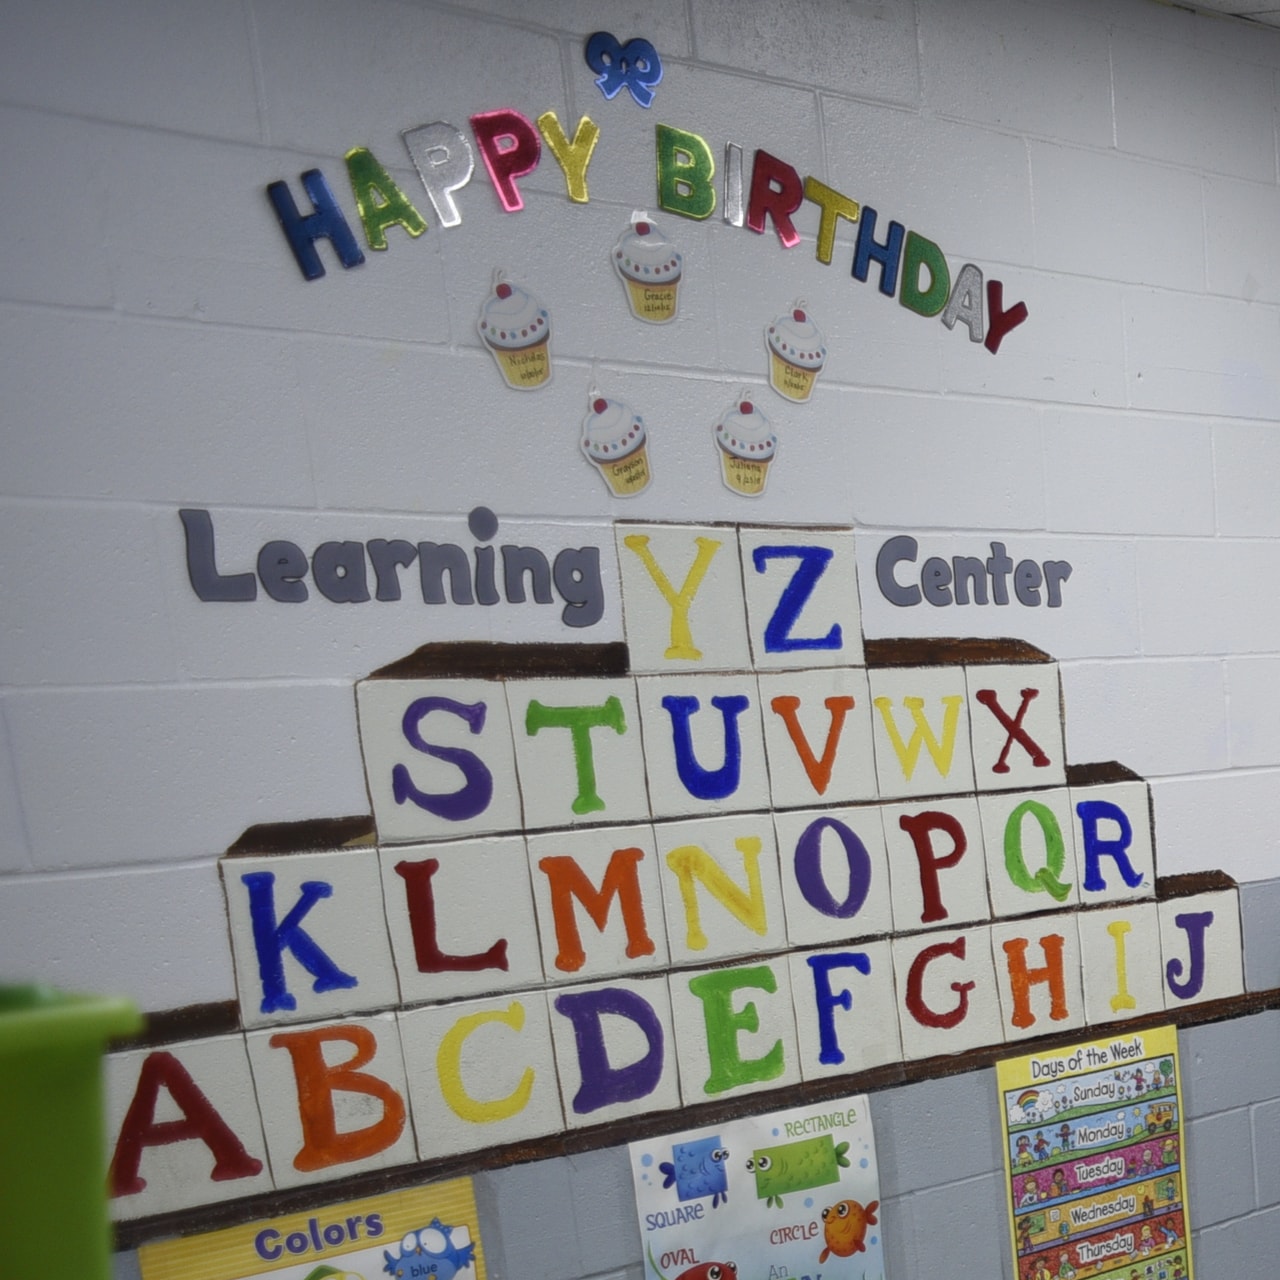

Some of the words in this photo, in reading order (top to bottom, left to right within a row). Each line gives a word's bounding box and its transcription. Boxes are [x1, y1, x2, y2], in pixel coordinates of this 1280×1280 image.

[266, 107, 600, 281] HAPPY
[654, 122, 1029, 356] BIRTHDAY
[179, 506, 605, 628] Learning
[875, 535, 1072, 608] Center
[624, 533, 723, 661] Y
[750, 544, 843, 654] Z
[392, 697, 494, 821] S
[524, 696, 627, 813] T
[660, 695, 750, 801] U
[770, 694, 855, 797] V
[873, 693, 963, 781] W
[975, 686, 1050, 776] X
[242, 870, 359, 1012] K
[394, 857, 508, 975] L
[537, 845, 655, 972] M
[666, 836, 768, 951] N
[792, 816, 871, 919] O
[899, 810, 967, 924] P
[1001, 799, 1073, 903] Q
[1080, 797, 1146, 893] R
[107, 1049, 262, 1197] A
[268, 1022, 408, 1174] B
[435, 1000, 536, 1125] C
[555, 985, 665, 1116] D
[674, 966, 786, 1094] E
[802, 951, 873, 1066] F
[904, 935, 975, 1031] G
[1000, 932, 1069, 1028] H
[1105, 919, 1134, 1010] I
[1164, 909, 1215, 1000] J
[1032, 1059, 1065, 1079] Days
[1068, 1050, 1083, 1070] of
[1086, 1048, 1109, 1066] the
[1110, 1038, 1143, 1060] Week
[1073, 1081, 1116, 1102] Sunday
[1078, 1123, 1124, 1145] Monday
[1076, 1157, 1124, 1181] Tuesday
[1070, 1195, 1137, 1226] Wednesday
[254, 1211, 385, 1262] Colors
[1077, 1233, 1134, 1263] Thursday
[410, 1261, 438, 1278] blue
[660, 1248, 700, 1270] OVAL
